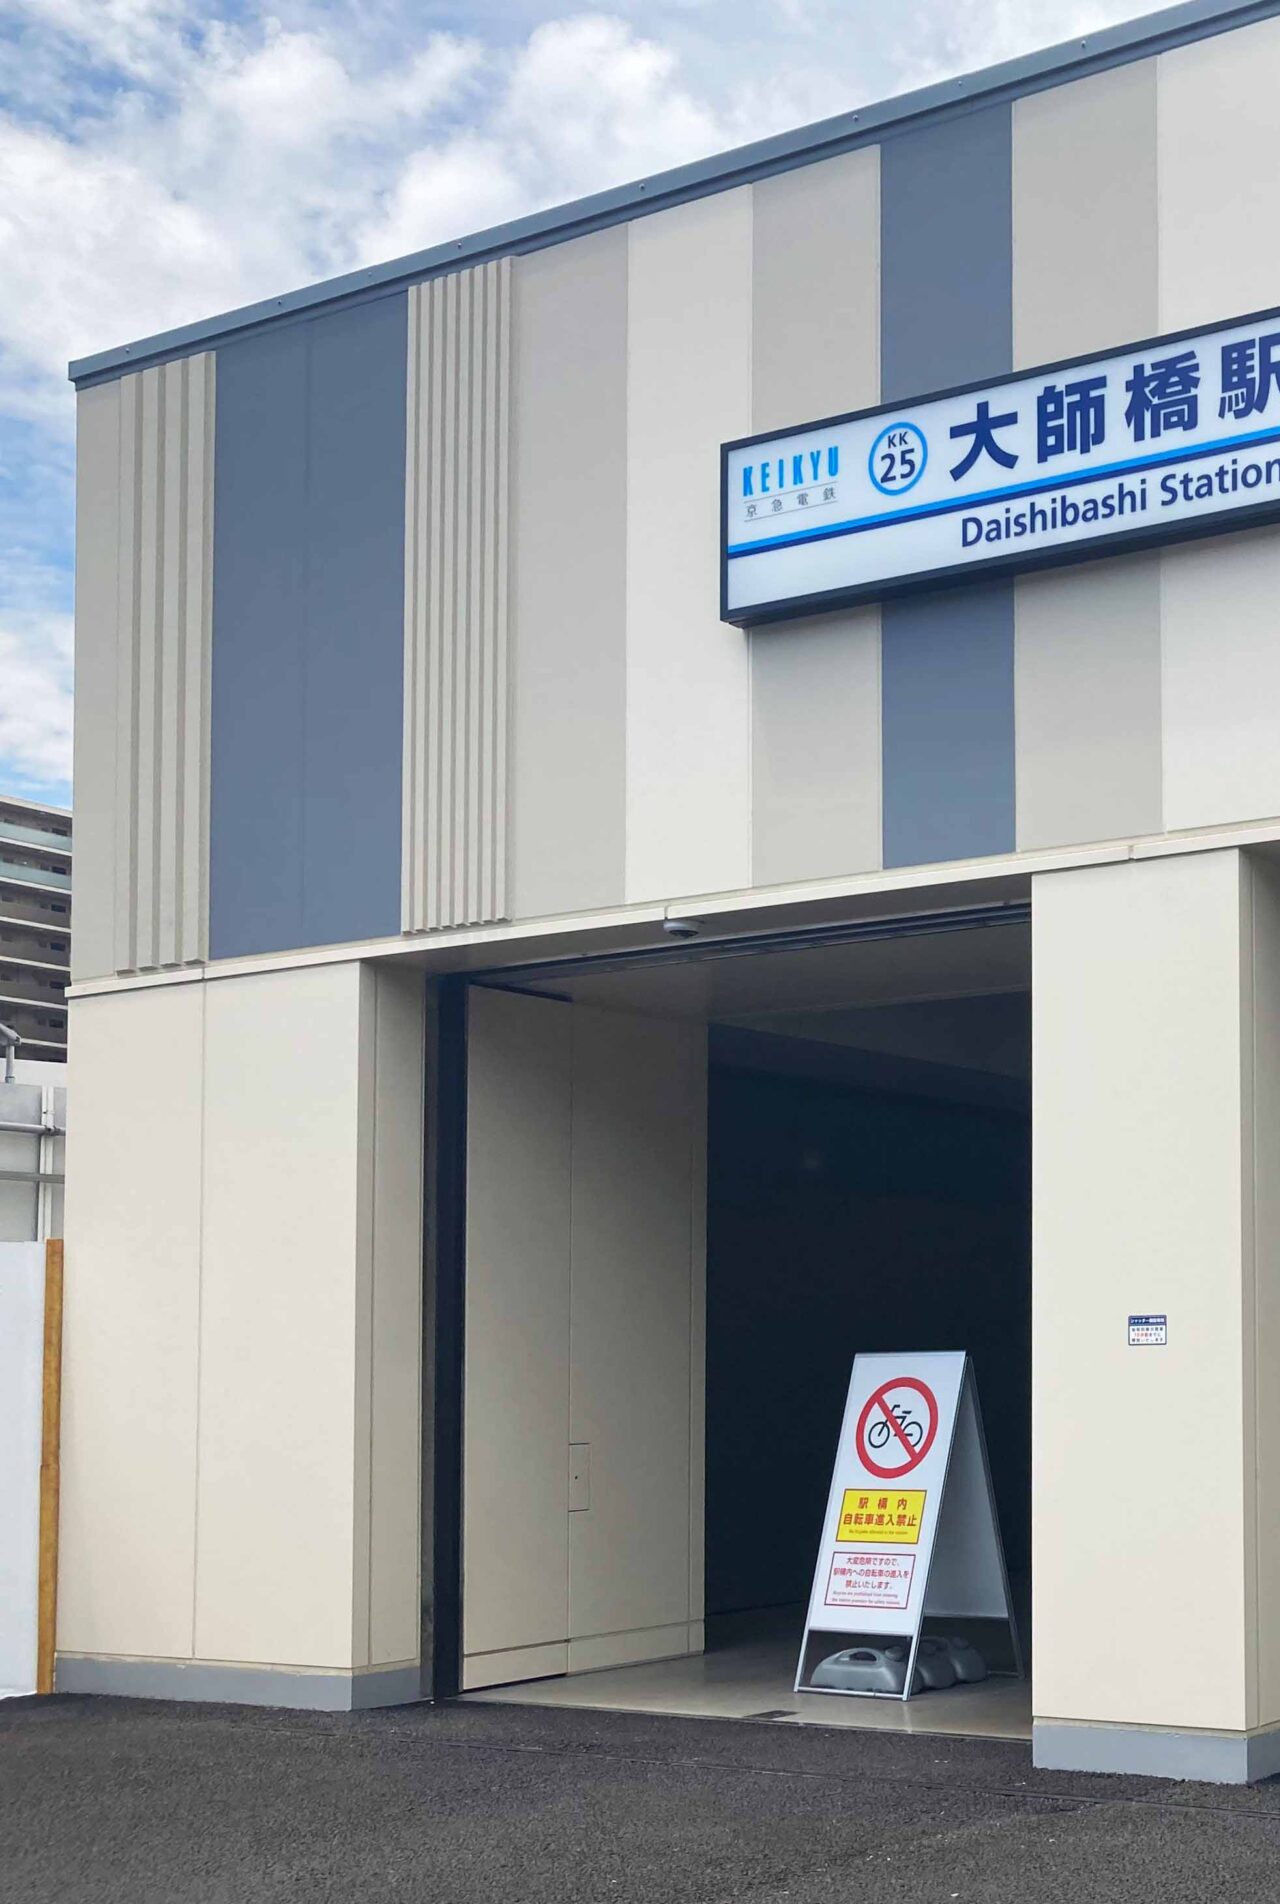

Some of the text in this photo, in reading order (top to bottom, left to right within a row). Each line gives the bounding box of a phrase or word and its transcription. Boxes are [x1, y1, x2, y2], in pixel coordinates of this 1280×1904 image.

[887, 431, 908, 449] KK
[743, 446, 839, 497] KEIKYU
[880, 448, 916, 483] 25
[746, 487, 836, 518] 京急電鉄
[962, 479, 1147, 547] Daishibashi
[843, 1513, 917, 1527] 自転車進入禁止
